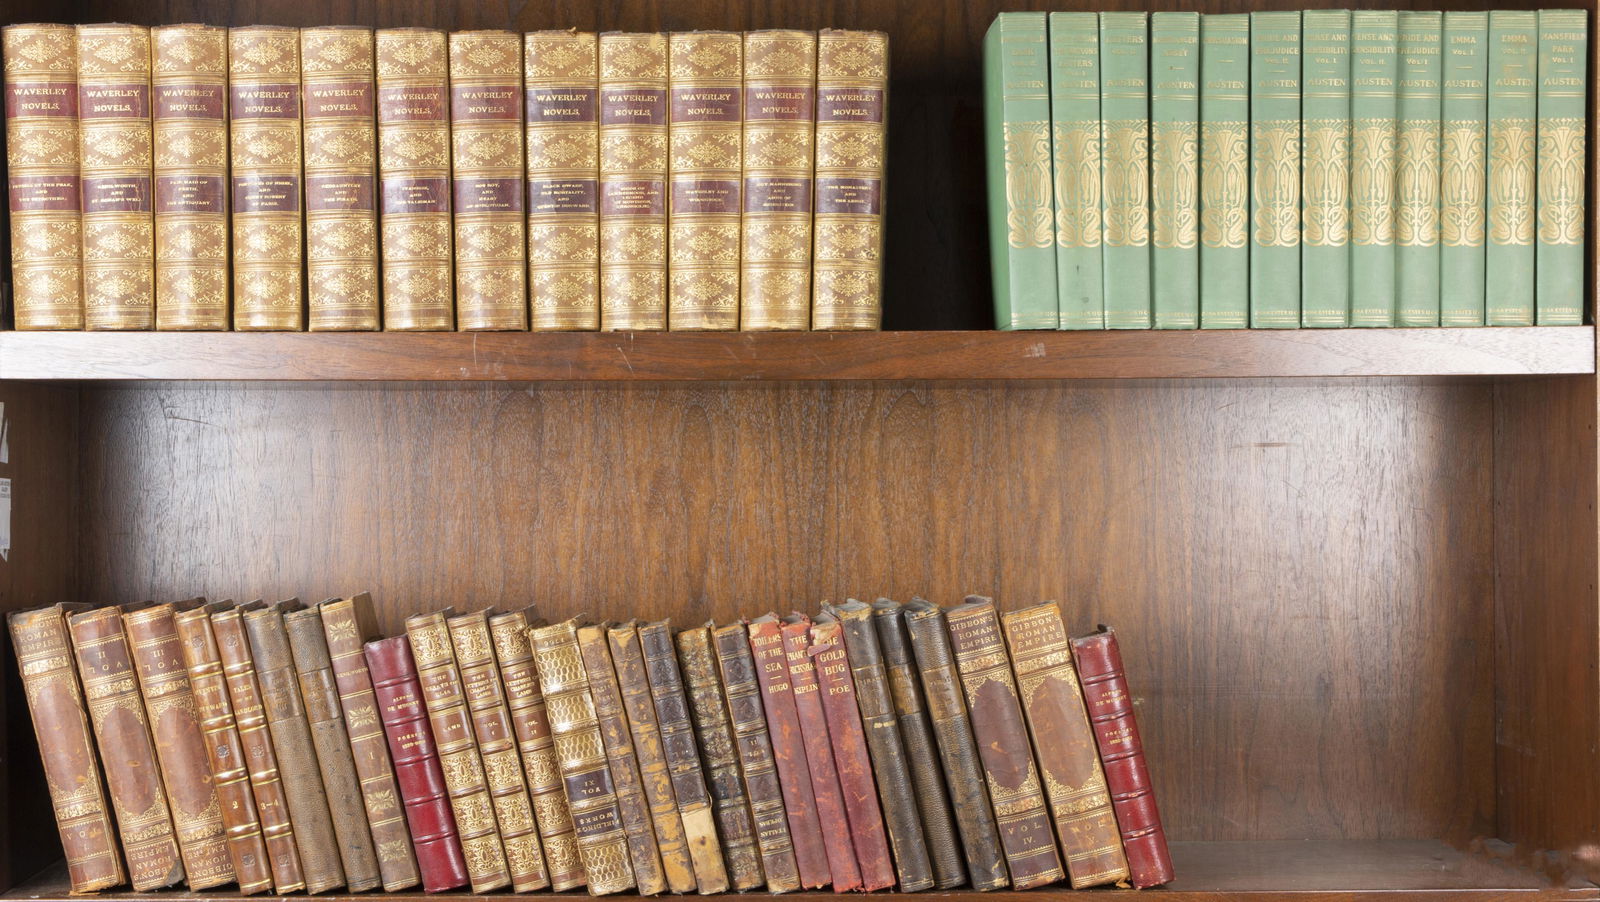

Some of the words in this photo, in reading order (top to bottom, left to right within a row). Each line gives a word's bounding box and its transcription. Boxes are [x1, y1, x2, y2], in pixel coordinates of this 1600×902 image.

[1282, 34, 1298, 42] AND
[1423, 34, 1440, 42] AND
[1450, 36, 1477, 44] EMMA
[1259, 80, 1298, 88] AUSTEN
[1307, 78, 1346, 87] AUSTEN
[1354, 78, 1393, 87] AUSTEN
[1399, 80, 1438, 88] AUSTEN
[1444, 80, 1483, 88] AUSTEN
[1496, 78, 1534, 87] AUSTEN
[1544, 78, 1584, 86] AUSTEN
[14, 88, 67, 96] WAVERLEY
[86, 89, 140, 98] WAVERLEY
[163, 89, 214, 98] WAVERLEY
[238, 91, 290, 99] WAVERLEY
[312, 89, 365, 98] WAVERLEY
[387, 92, 439, 101] WAVERLEY
[462, 91, 513, 100] WAVERLEY
[755, 92, 806, 100] WAVERLEY
[536, 94, 588, 102] WAVERLEY
[608, 94, 659, 103] WAVERLEY
[680, 93, 731, 102] WAVERLEY
[826, 94, 876, 102] WAVERLEY
[950, 616, 993, 632] GIBBON'S
[1012, 616, 1060, 632] GIBBON'S
[20, 629, 57, 642] ROMAN
[959, 626, 993, 640] ROMAN
[1016, 625, 1056, 640] ROMAN
[754, 635, 782, 646] TOILERS
[790, 636, 808, 646] THE
[960, 636, 997, 650] EMPIRE
[1018, 632, 1062, 648] EMPIRE
[758, 650, 768, 660] OF
[769, 648, 783, 657] THE
[820, 650, 845, 662] GOLD
[765, 662, 782, 673] SEA
[790, 663, 815, 674] RICKSHA
[824, 664, 846, 676] BUG
[472, 672, 485, 680] THE
[768, 682, 788, 694] HUGO
[794, 684, 818, 695] KIPLIN
[829, 685, 850, 696] POE
[232, 801, 238, 809] 2
[579, 812, 614, 824] WORKS
[760, 828, 786, 837] ITALIAN
[132, 846, 170, 860] EMPIRE
[136, 856, 171, 870] ROMAN
[191, 854, 227, 869] ROMAN
